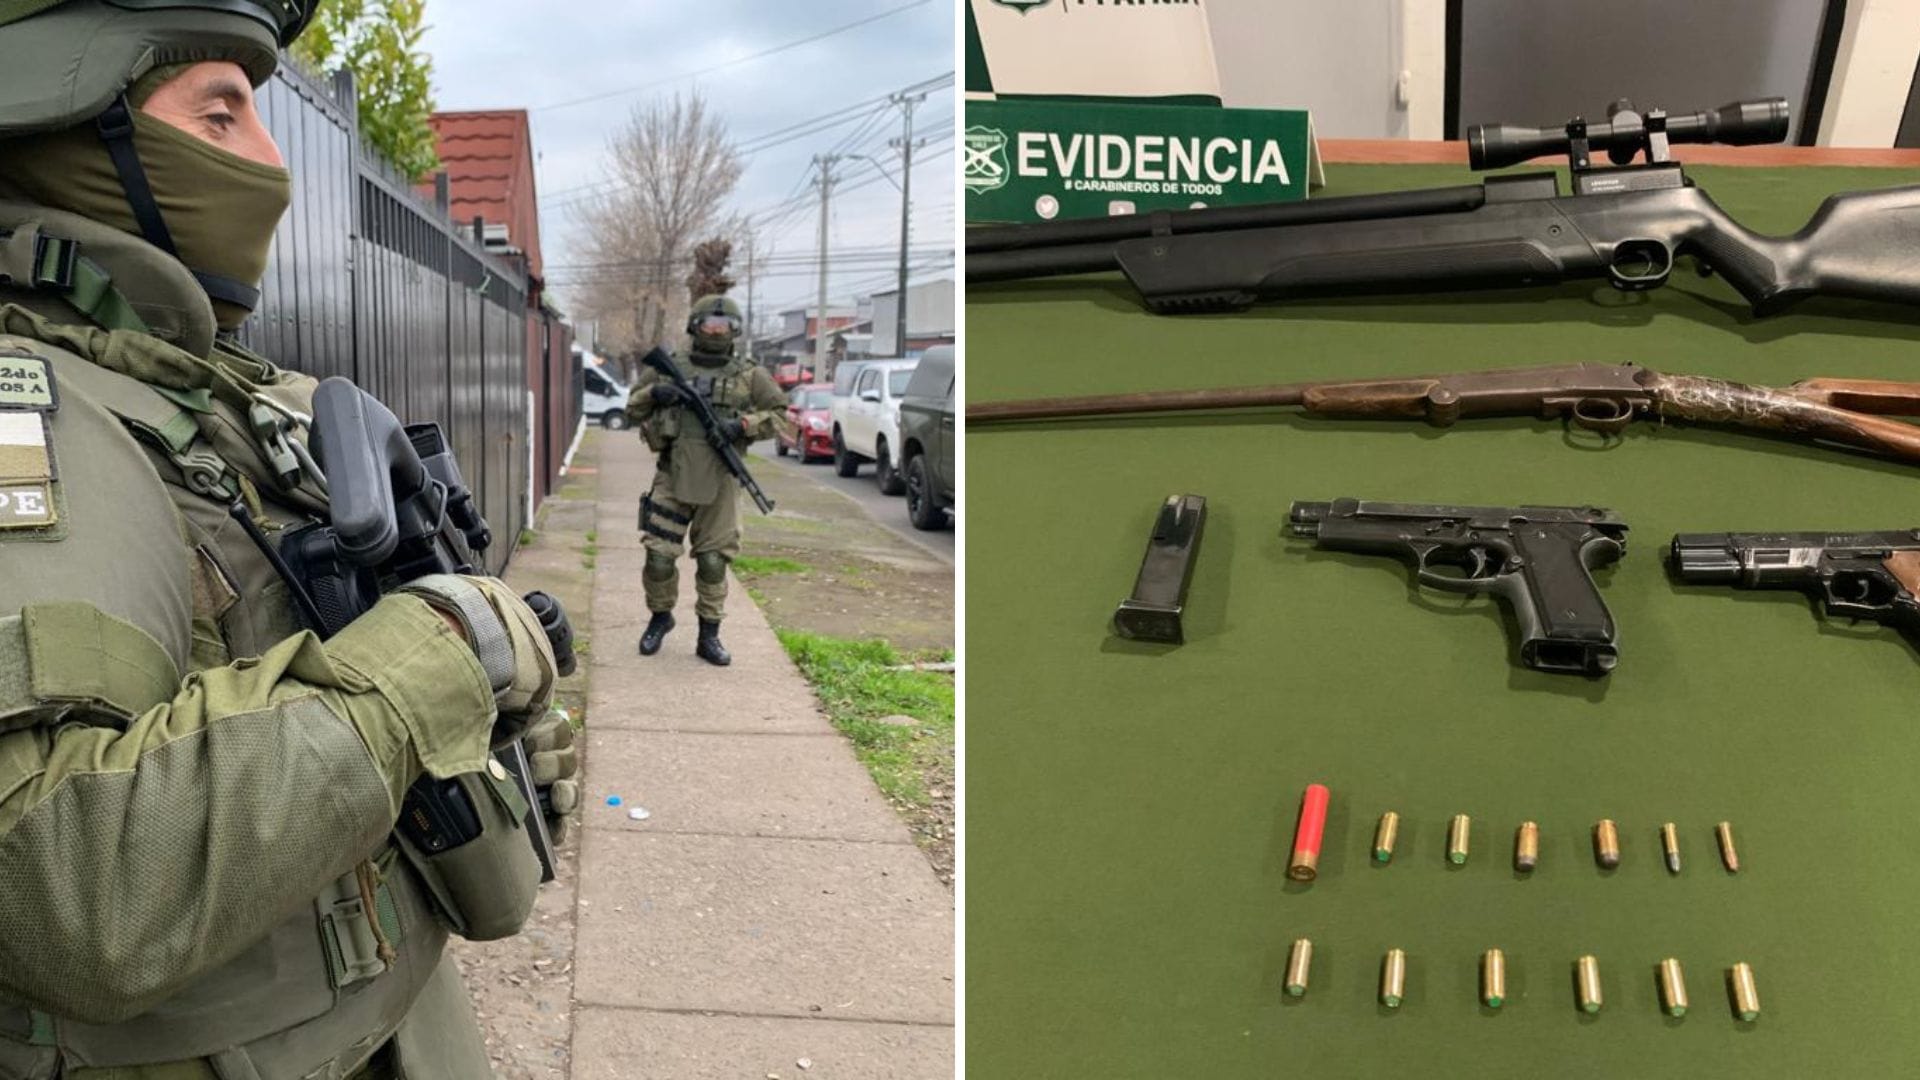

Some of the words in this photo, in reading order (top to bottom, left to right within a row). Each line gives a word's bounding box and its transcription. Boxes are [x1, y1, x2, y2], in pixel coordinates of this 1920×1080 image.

[1018, 132, 1290, 185] EVIDENCIA
[1162, 183, 1179, 194] DE
[1182, 183, 1223, 196] TODOS
